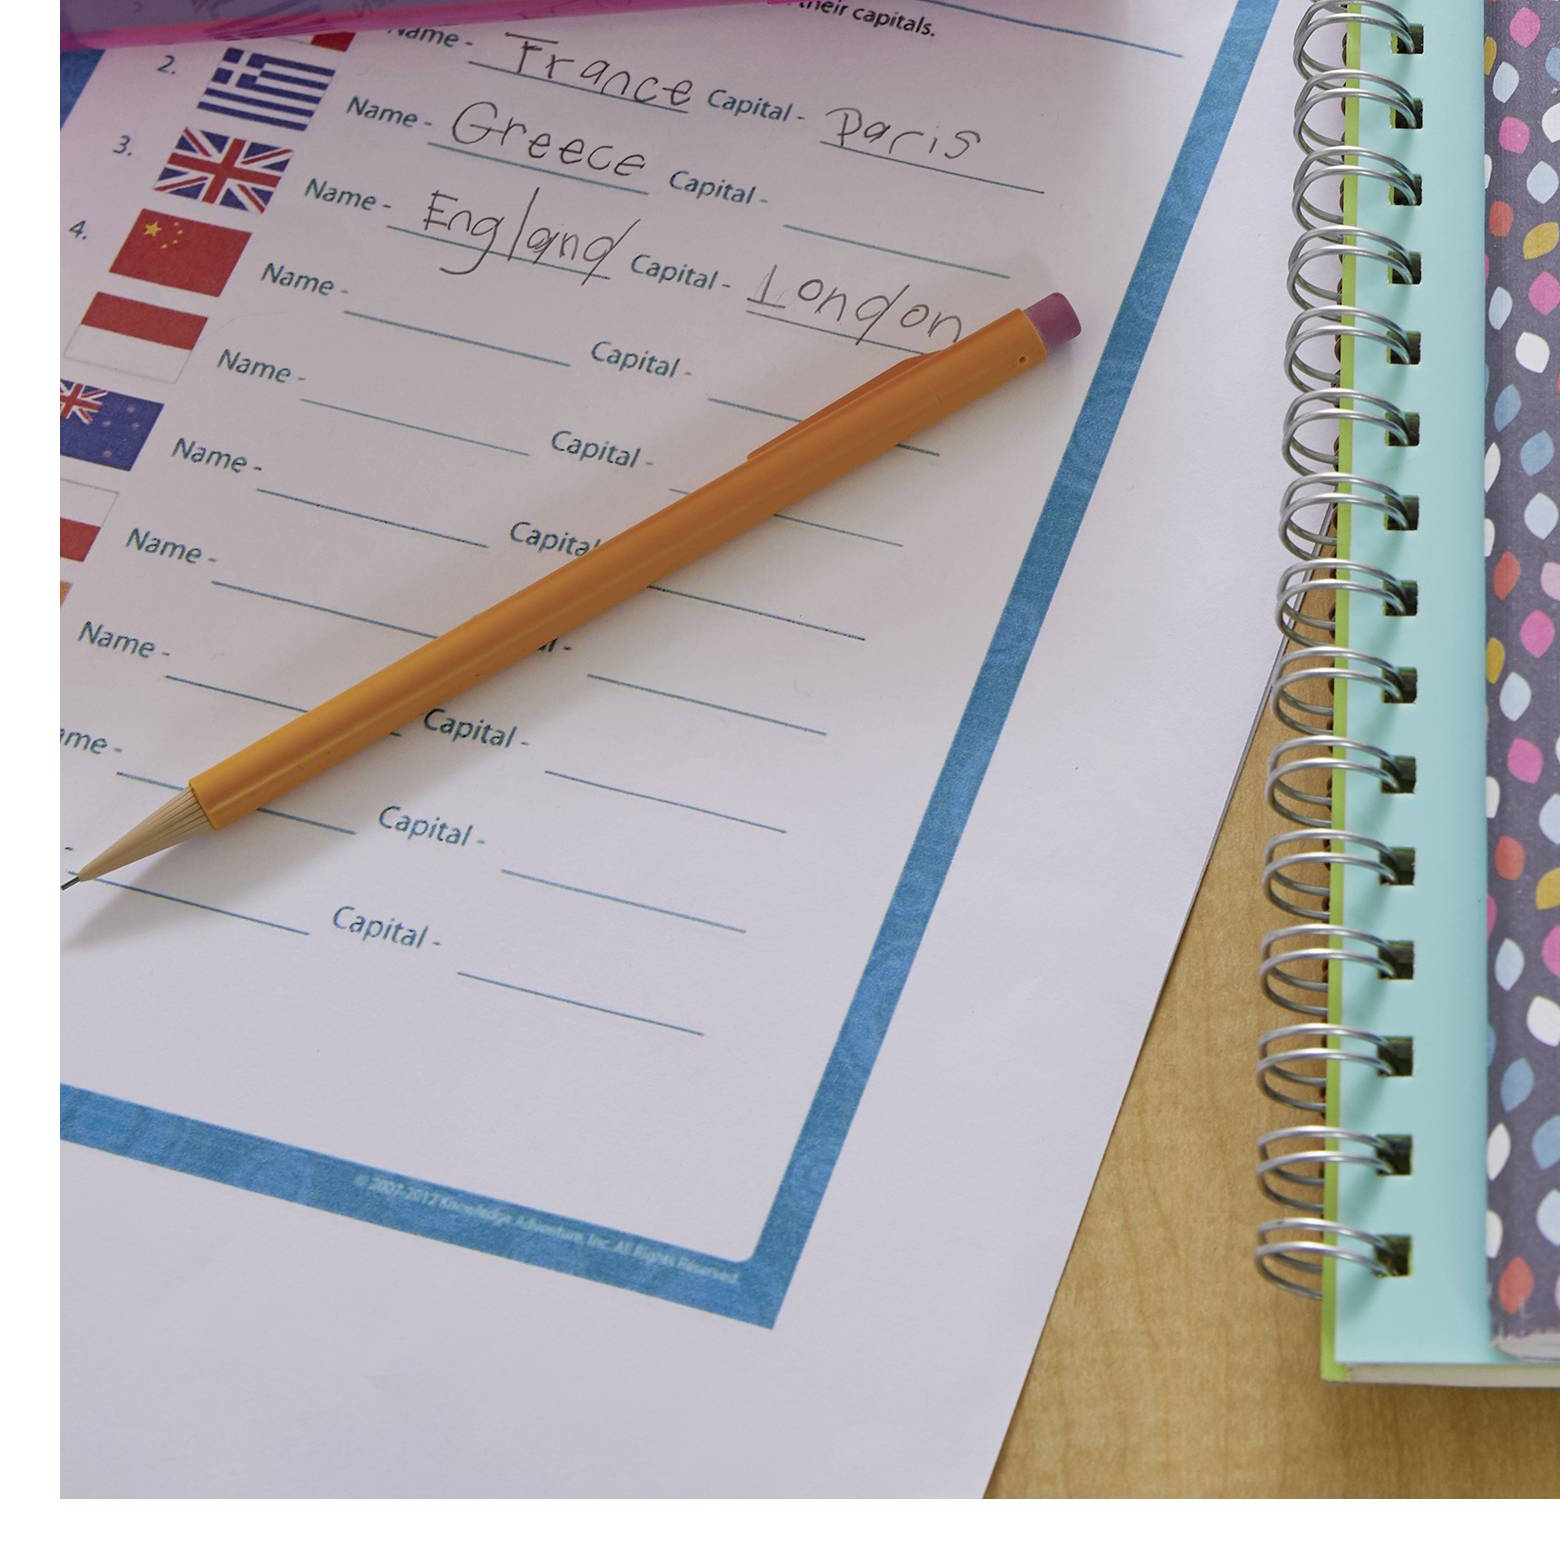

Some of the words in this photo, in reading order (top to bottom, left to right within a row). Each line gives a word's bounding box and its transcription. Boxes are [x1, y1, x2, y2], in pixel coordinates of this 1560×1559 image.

[388, 27, 460, 48] ame
[852, 6, 936, 38] capitals.
[157, 54, 177, 75] 2.
[505, 31, 694, 108] France
[346, 95, 418, 128] Name
[707, 88, 795, 123] Capital
[112, 134, 134, 157] 3.
[451, 100, 648, 179] Greece
[826, 106, 982, 160] Paris
[304, 177, 378, 212] Name
[668, 170, 756, 206] Capital
[68, 219, 89, 241] 4.
[422, 186, 642, 287] England
[260, 261, 335, 296] Name
[630, 253, 719, 291] Capital
[746, 263, 963, 346] London
[216, 347, 292, 383] Name
[590, 340, 681, 379] Capital
[171, 437, 248, 475] Name
[551, 429, 642, 468] Capital
[125, 527, 203, 566] Name
[78, 621, 156, 660] Name
[423, 707, 518, 749] Capital
[378, 804, 475, 848] Capital
[331, 904, 429, 949] Capital
